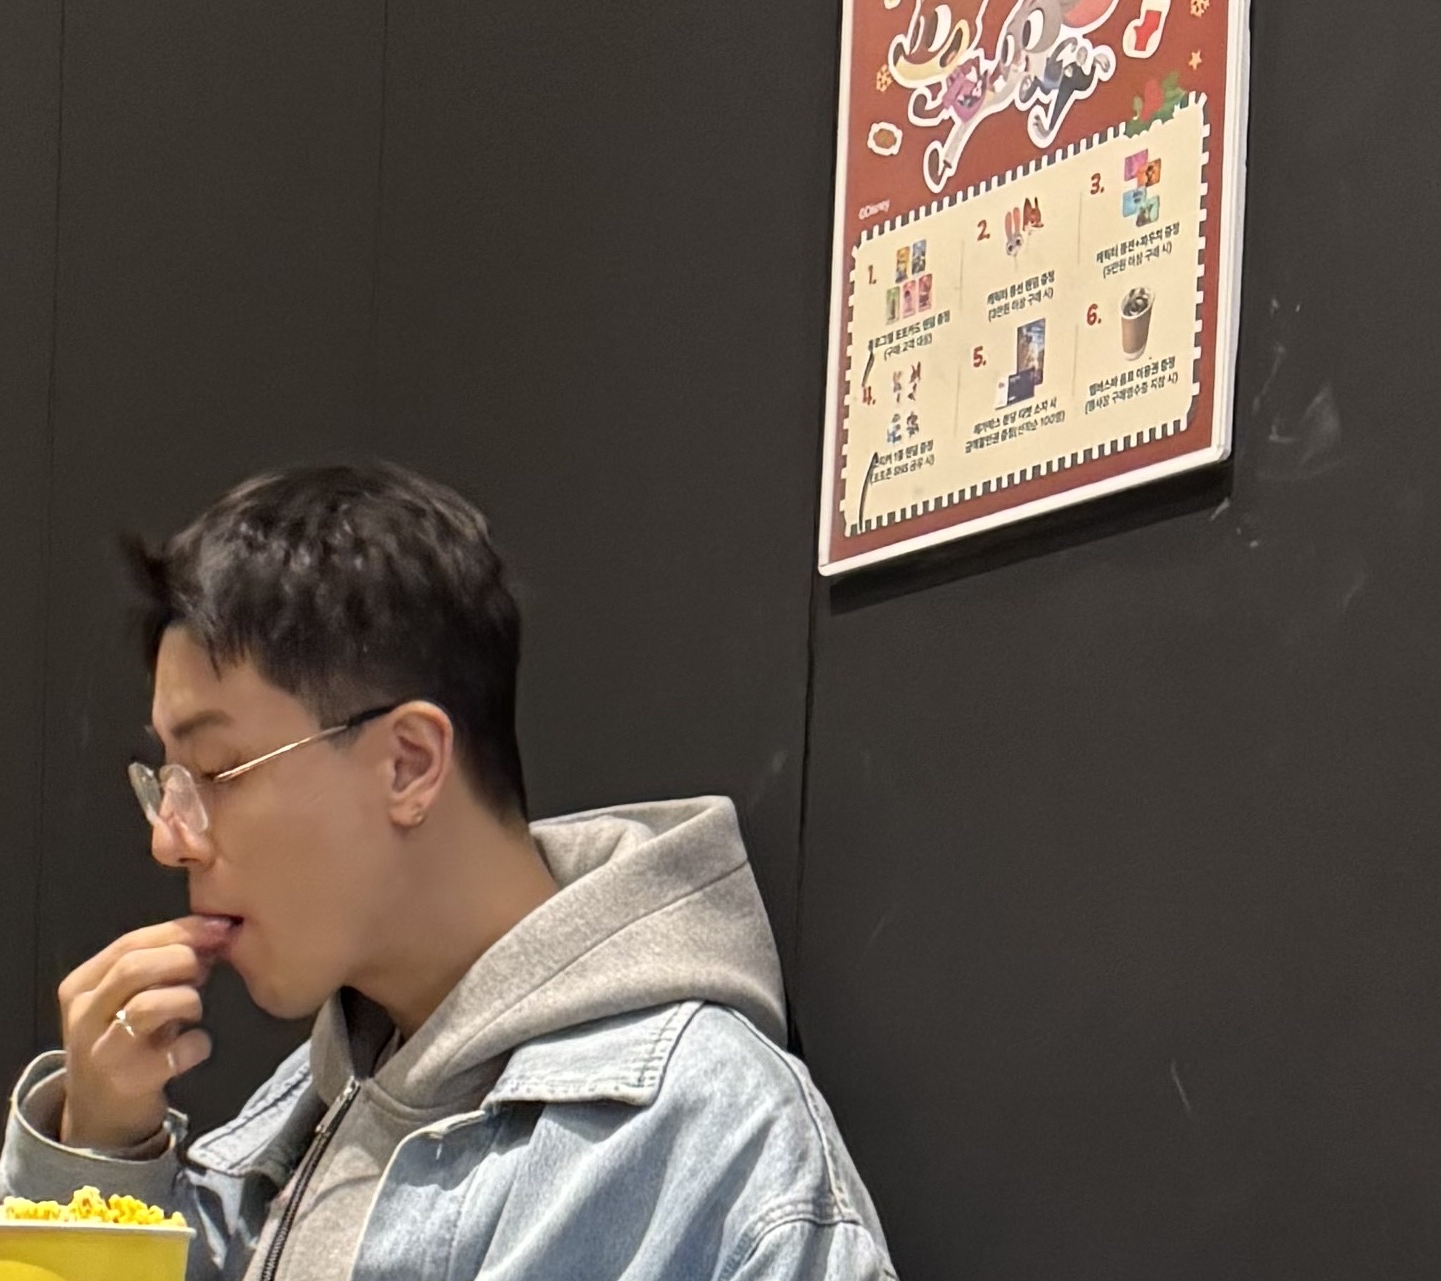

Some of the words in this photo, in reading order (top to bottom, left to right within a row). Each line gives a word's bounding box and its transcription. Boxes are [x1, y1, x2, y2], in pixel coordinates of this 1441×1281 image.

[1090, 173, 1104, 194] 3.
[976, 220, 990, 241] 2.
[868, 265, 877, 284] 1.
[1087, 304, 1101, 325] 6.
[973, 346, 986, 367] 5.
